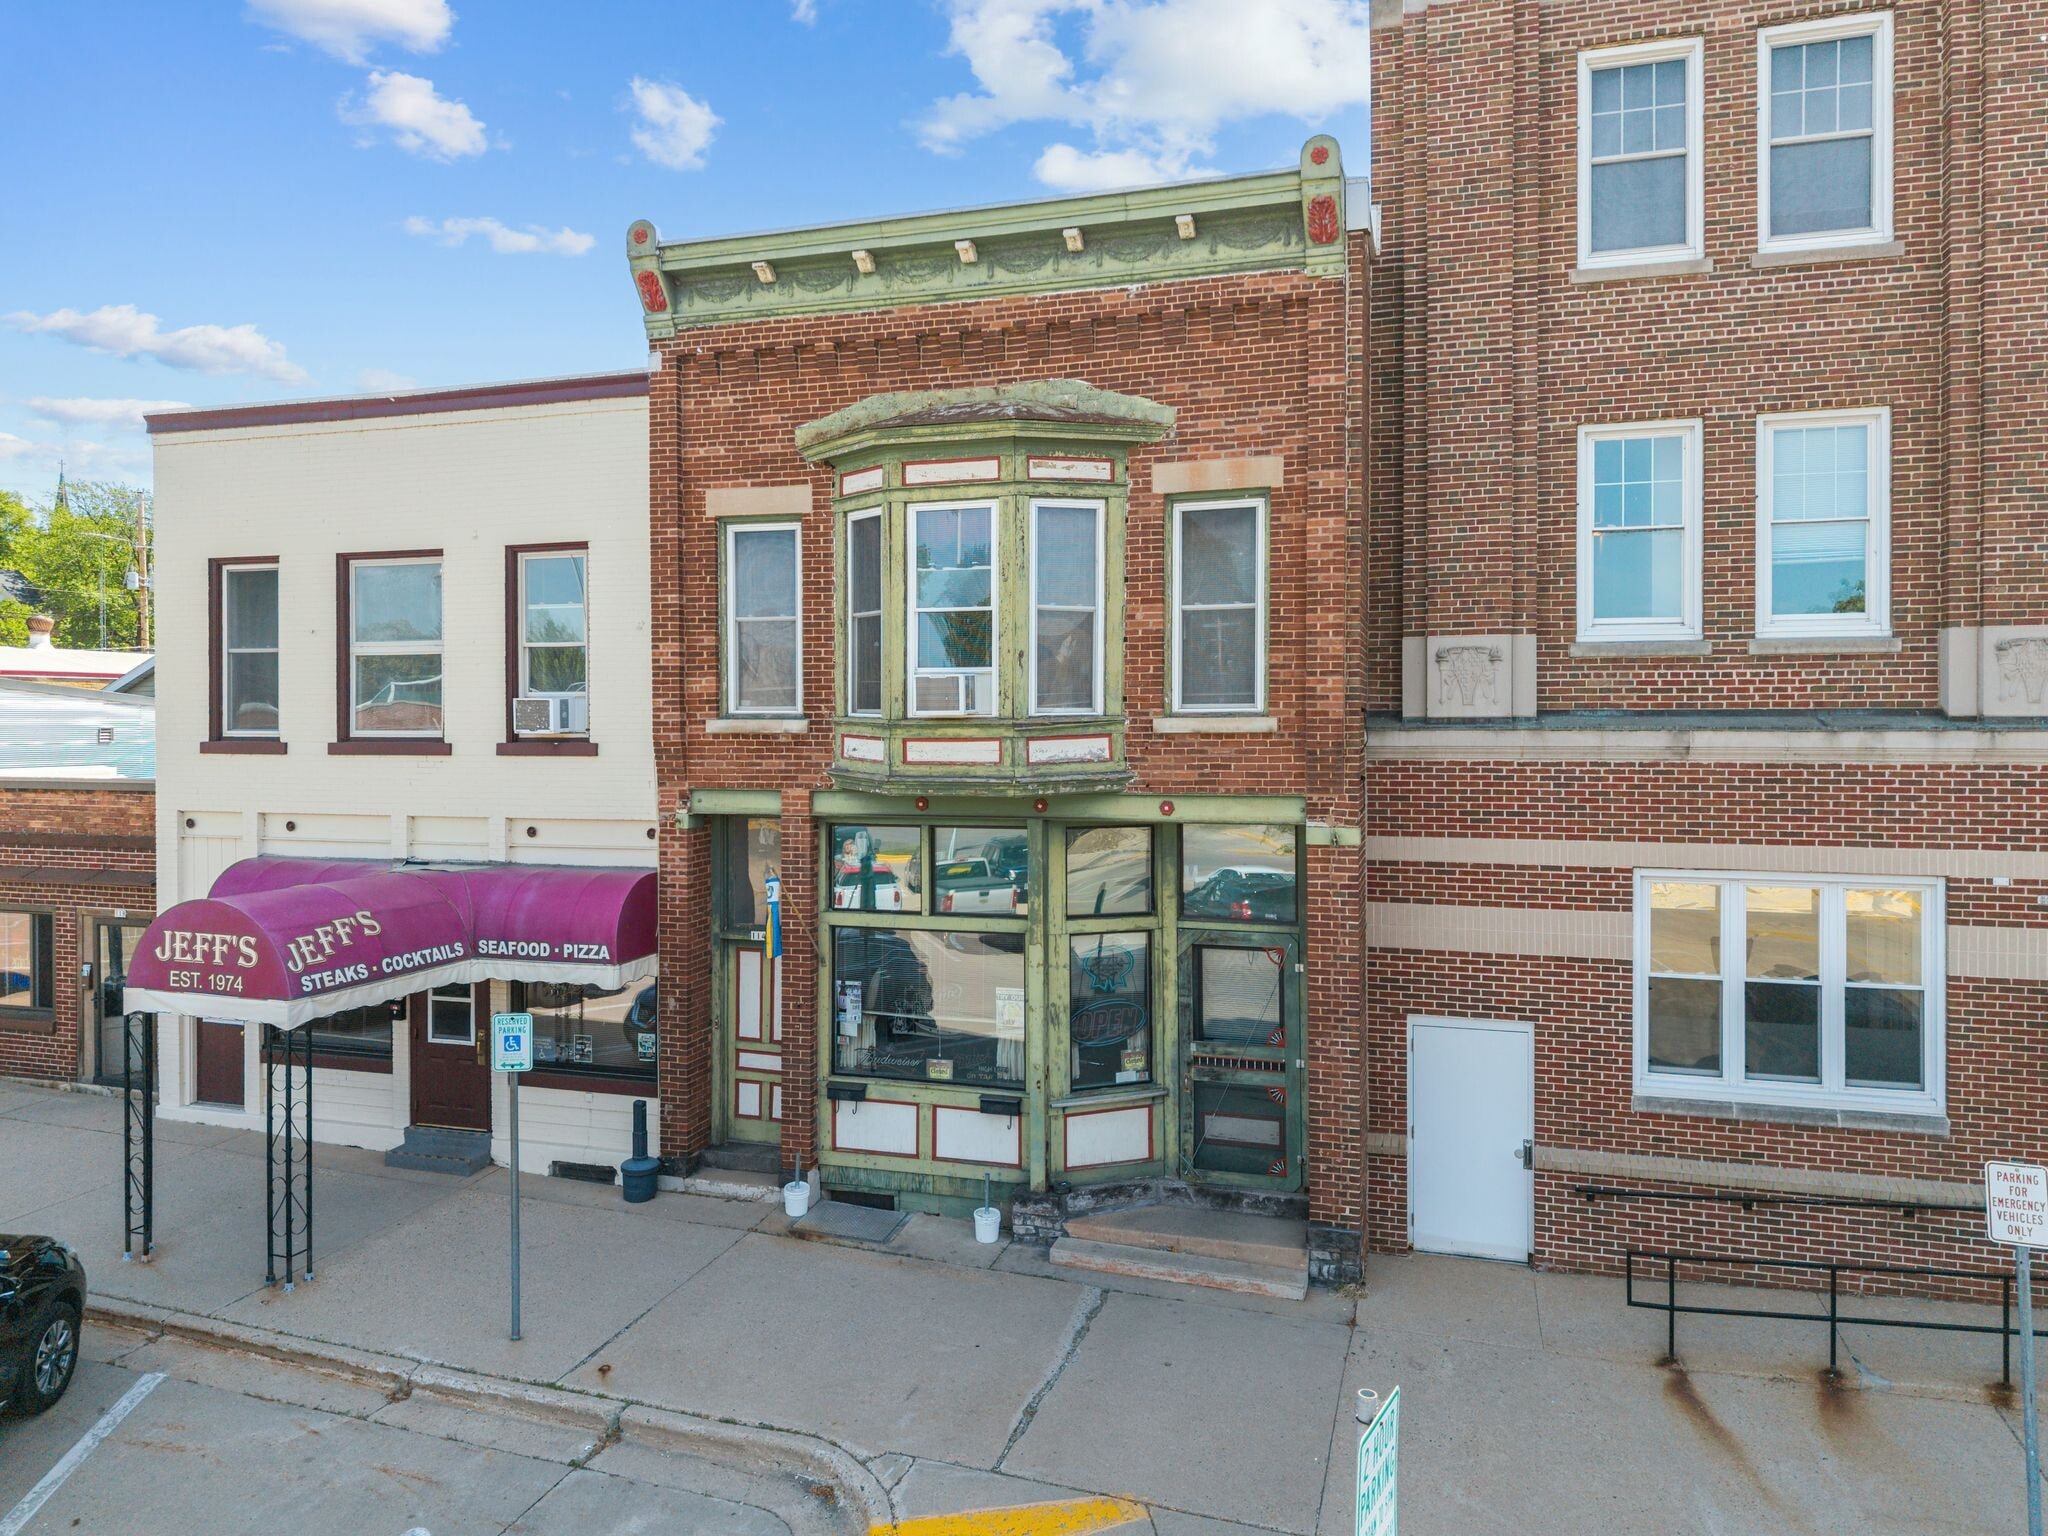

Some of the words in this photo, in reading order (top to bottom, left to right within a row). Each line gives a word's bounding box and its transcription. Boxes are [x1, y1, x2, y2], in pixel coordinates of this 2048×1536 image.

[154, 930, 259, 968] JEFF'S
[286, 910, 382, 974] JEFF'S
[478, 940, 550, 957] SEAFOOD
[563, 944, 610, 960] PIZZA
[300, 963, 369, 992] STEAKS
[381, 942, 465, 973] COCKTAILS
[169, 970, 203, 989] EST.
[208, 973, 244, 992] 1974
[497, 1017, 528, 1026] RESERVED
[498, 1026, 527, 1034] PARKING
[1076, 1007, 1138, 1040] OPEN
[859, 1052, 922, 1067] Budweiser
[1996, 1171, 2039, 1186] PARKING
[2009, 1186, 2028, 1197] FOR
[1992, 1196, 2046, 1213] EMERGENCY
[1996, 1210, 2044, 1226] VEHICLES
[2007, 1224, 2033, 1238] ONLY
[1363, 1447, 1370, 1482] 2
[1373, 1408, 1395, 1468] HOUR
[1360, 1445, 1395, 1528] PARKING
